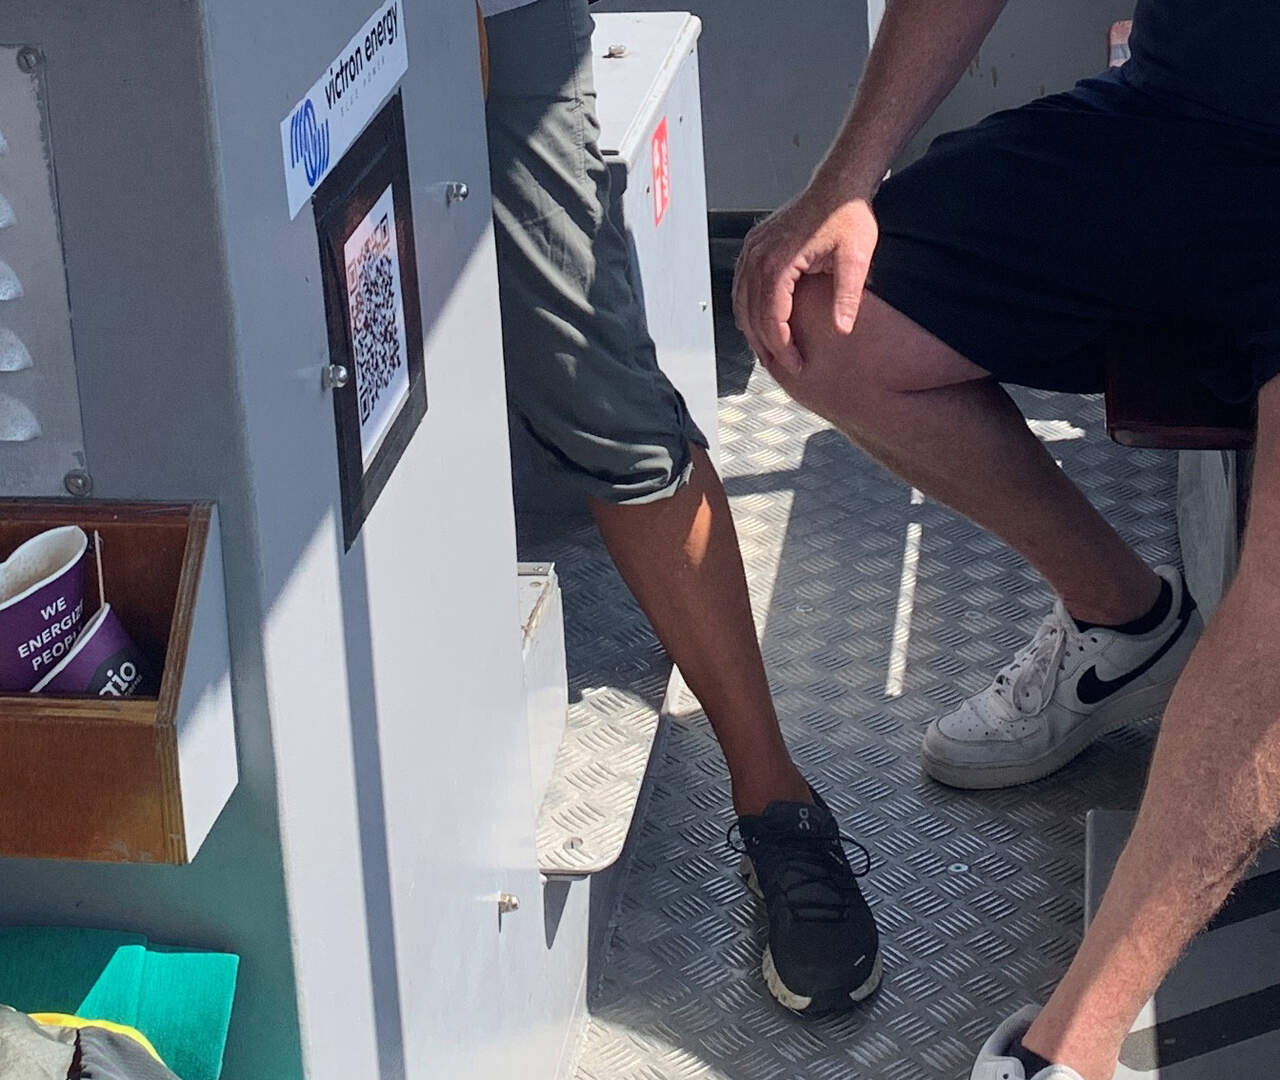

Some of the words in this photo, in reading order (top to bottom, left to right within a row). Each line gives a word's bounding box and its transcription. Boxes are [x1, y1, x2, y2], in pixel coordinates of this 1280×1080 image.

[324, 46, 363, 110] victron
[364, 1, 398, 62] energy
[18, 599, 84, 658] ENERGIZ
[40, 597, 67, 620] WE
